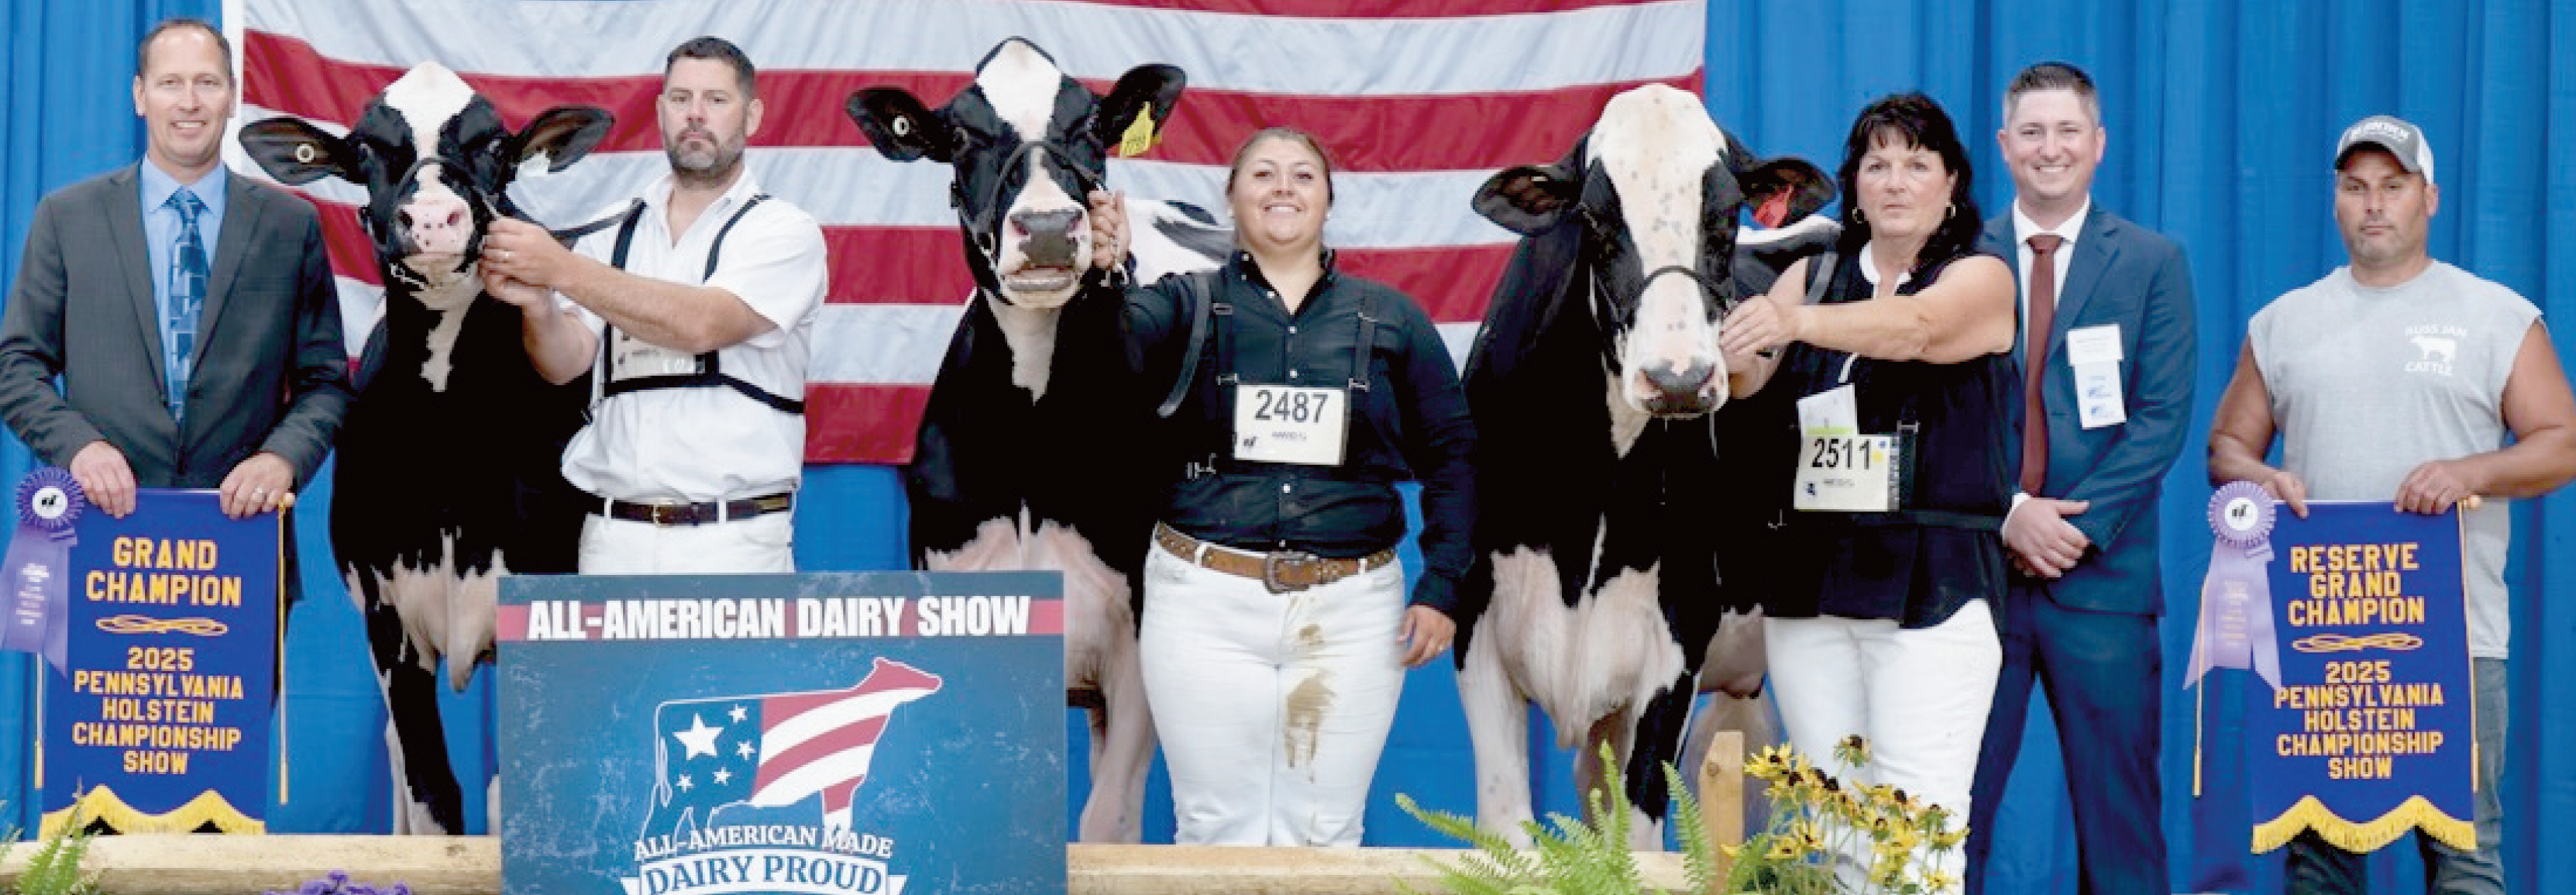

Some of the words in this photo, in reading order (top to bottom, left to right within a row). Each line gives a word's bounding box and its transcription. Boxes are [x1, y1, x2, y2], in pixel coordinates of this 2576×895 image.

[2405, 361, 2453, 377] CATTLE
[1255, 390, 1328, 424] 2487
[1811, 438, 1871, 470] 2511
[114, 537, 218, 571] GRAND
[2290, 543, 2420, 573] RESERVE
[86, 571, 242, 607] CHAMPION
[2309, 572, 2402, 598] GRAND
[528, 598, 785, 641] ALL-AMERICAN
[797, 597, 906, 638] DAIRY
[917, 595, 1031, 636] SHOW
[2288, 596, 2425, 625] CHAMPION
[128, 647, 193, 672] 2025
[2325, 661, 2392, 683] 2025
[74, 671, 244, 699] PENNSYLVANIA
[2275, 683, 2444, 709] PENNSYLVANIA
[102, 698, 214, 723] HOLSTEIN
[2304, 707, 2416, 731] HOLSTEIN
[72, 722, 242, 751] CHAMPIONSHIP
[2277, 731, 2444, 756] CHAMPIONSHIP
[123, 751, 188, 774] SHOW
[2327, 757, 2392, 780] SHOW
[634, 824, 817, 862] ALL-AMERICAN
[820, 824, 894, 859] MADE
[645, 855, 755, 895] DAIRY
[763, 855, 883, 894] PROUD
